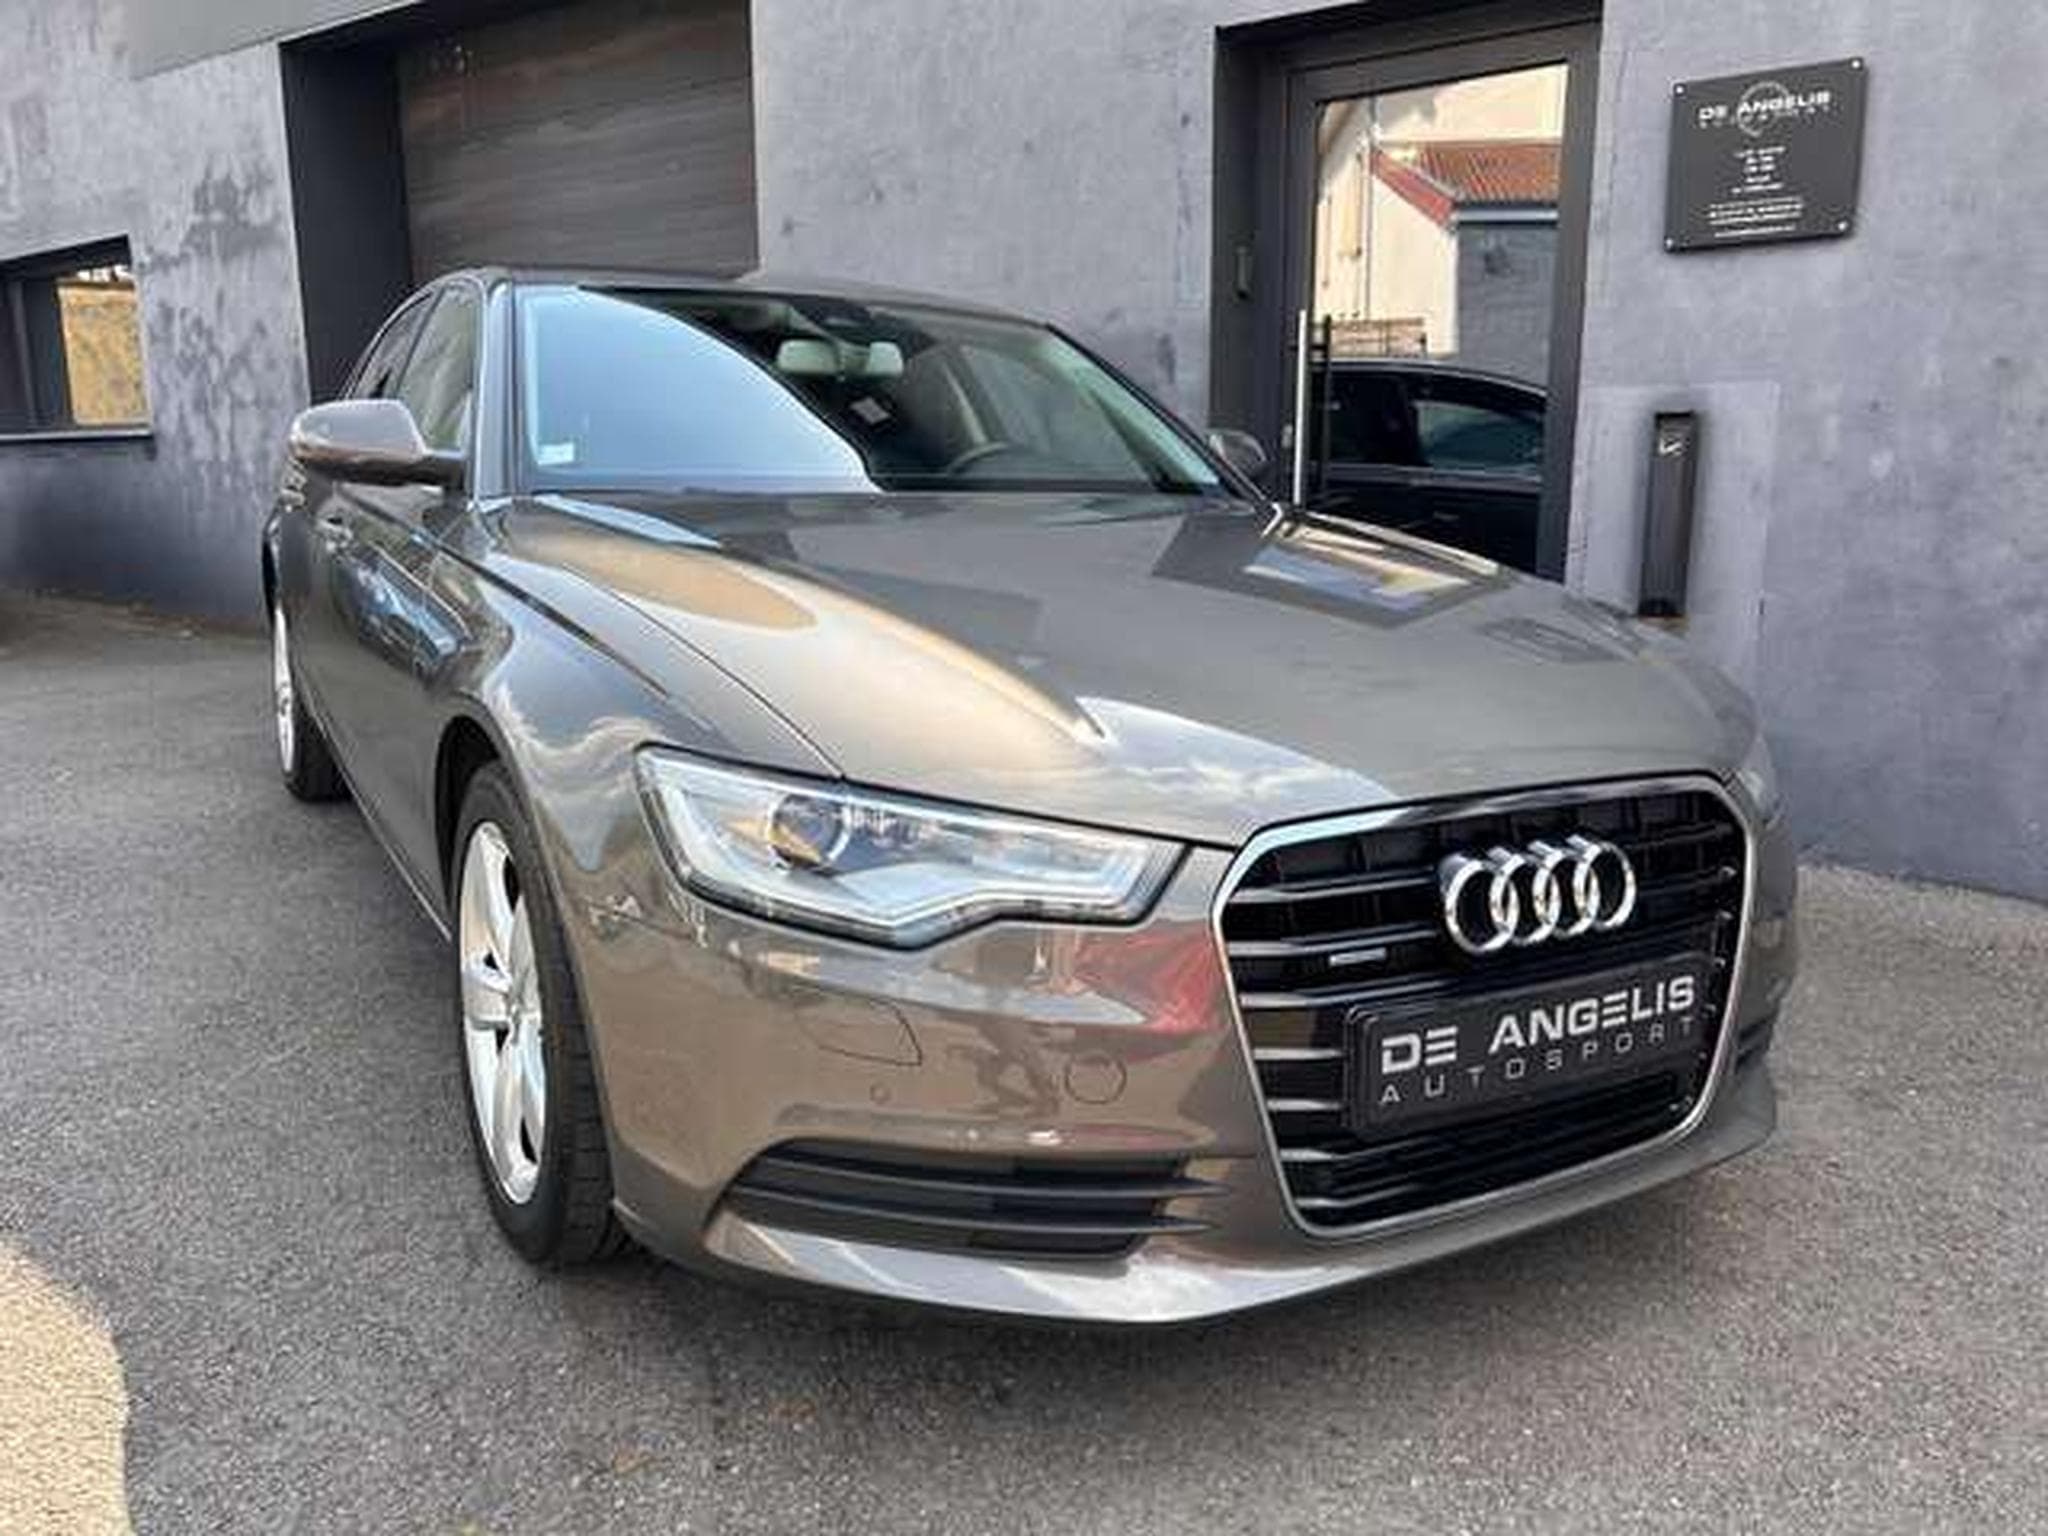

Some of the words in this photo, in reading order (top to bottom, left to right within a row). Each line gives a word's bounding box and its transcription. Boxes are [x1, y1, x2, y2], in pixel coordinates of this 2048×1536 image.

[1379, 1017, 1694, 1106] AUTOSPORT
[1382, 1025, 1458, 1074] DE
[1488, 975, 1695, 1054] ANGELIS
